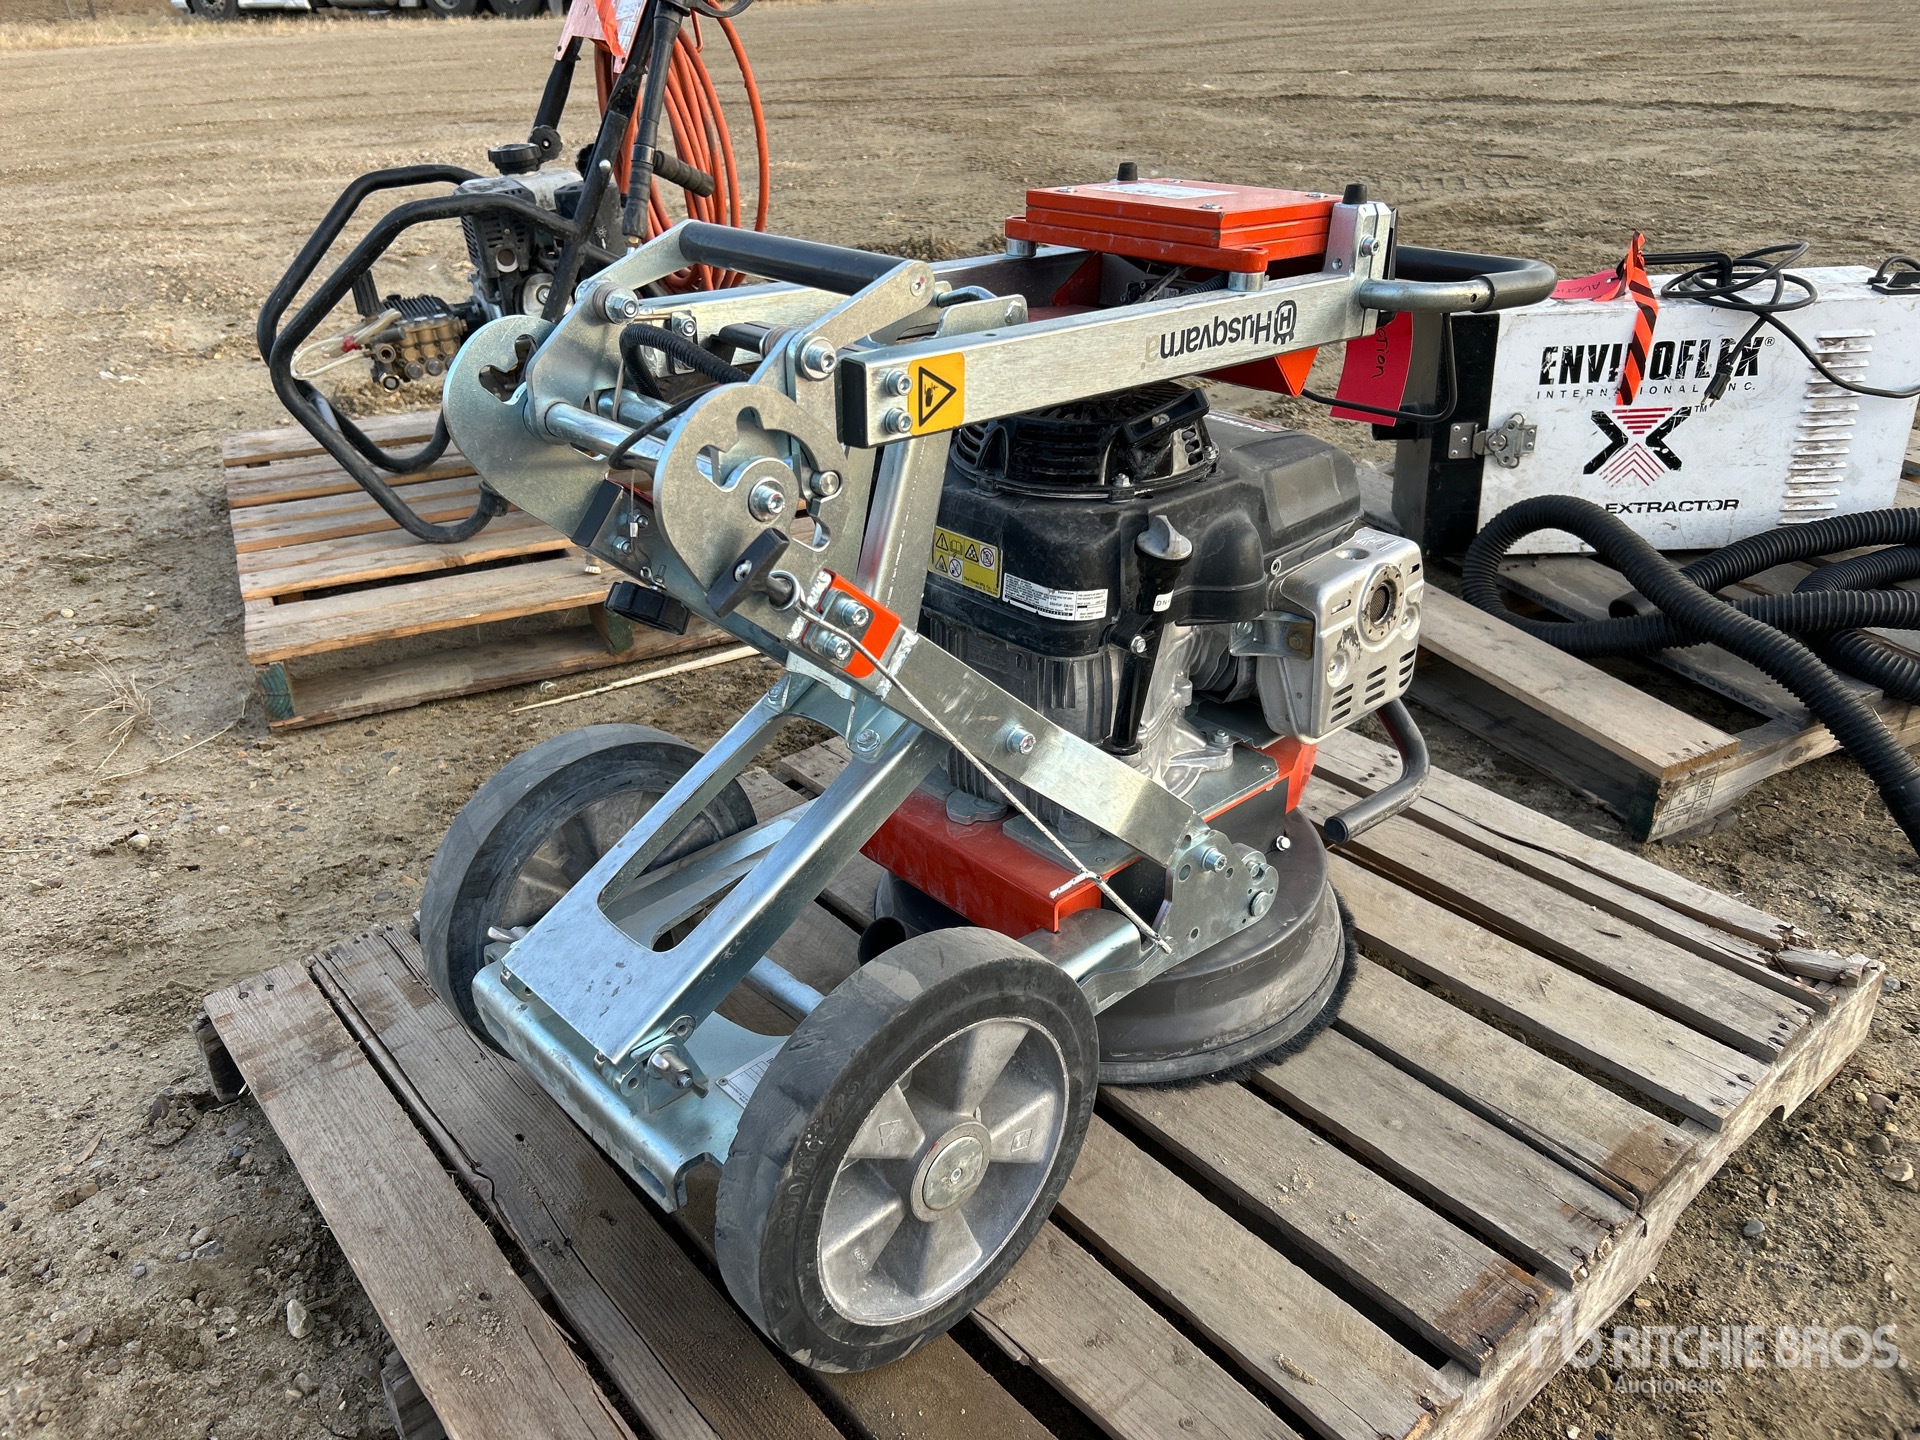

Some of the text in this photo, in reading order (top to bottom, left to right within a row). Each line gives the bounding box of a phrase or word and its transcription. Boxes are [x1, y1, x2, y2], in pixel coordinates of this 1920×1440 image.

[1144, 310, 1273, 363] Husqvarna
[1538, 336, 1765, 386] ENVIOFLEX
[1536, 384, 1700, 400] INTERNIONAL
[1605, 498, 1740, 515] EXTRACTOR
